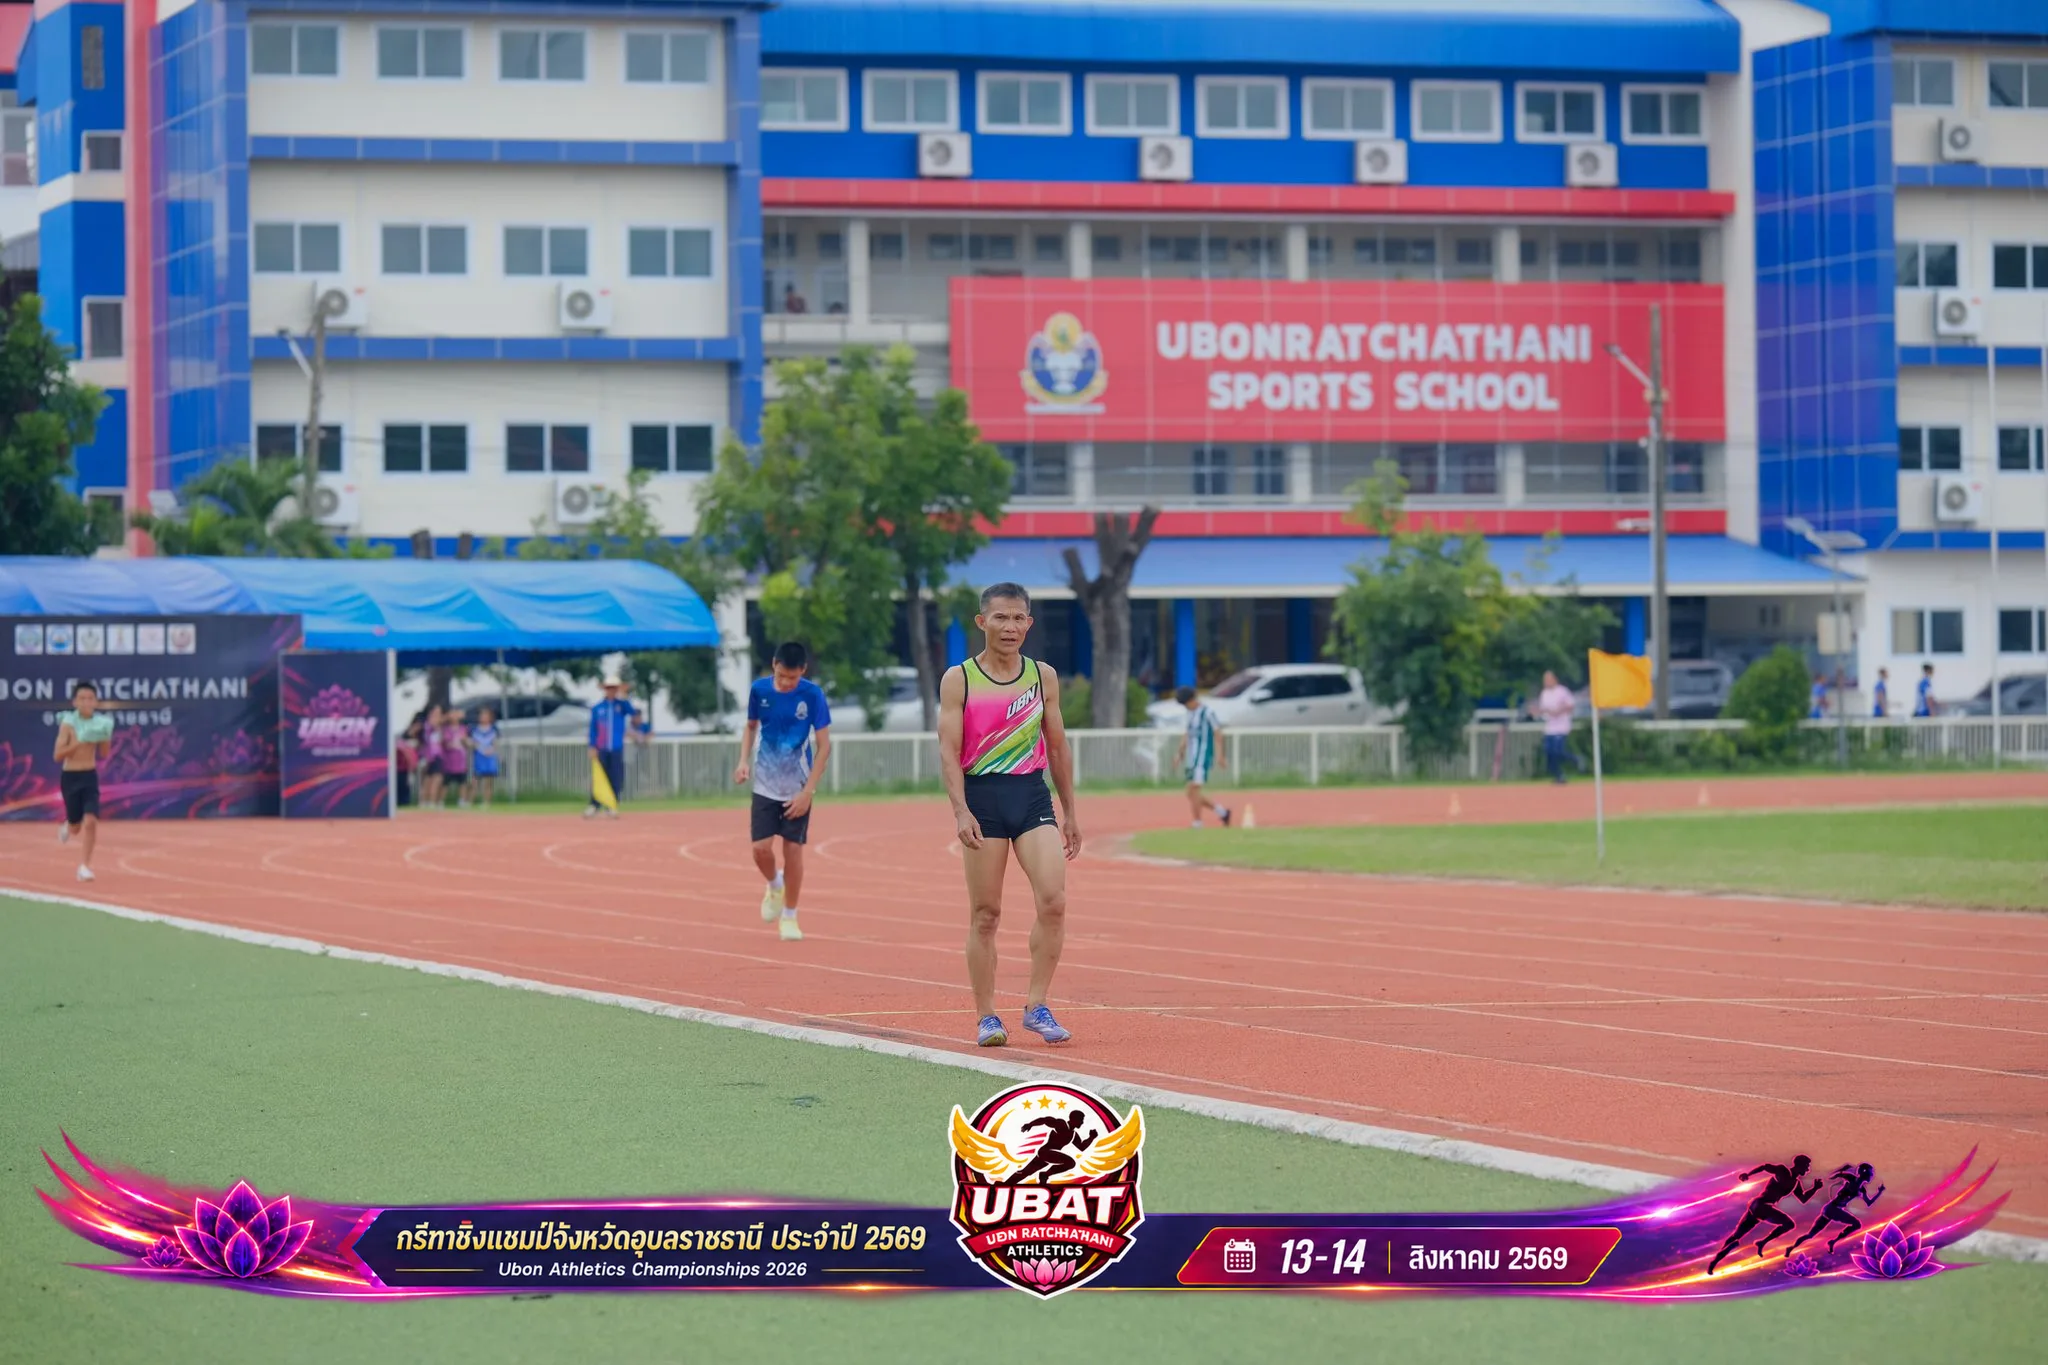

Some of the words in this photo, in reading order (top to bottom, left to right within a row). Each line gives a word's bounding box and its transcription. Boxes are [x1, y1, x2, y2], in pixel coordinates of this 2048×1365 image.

[1157, 321, 1592, 363] UBONRATCHATHANI
[1208, 372, 1374, 411] SPORTS
[1394, 372, 1560, 411] SCHOOL
